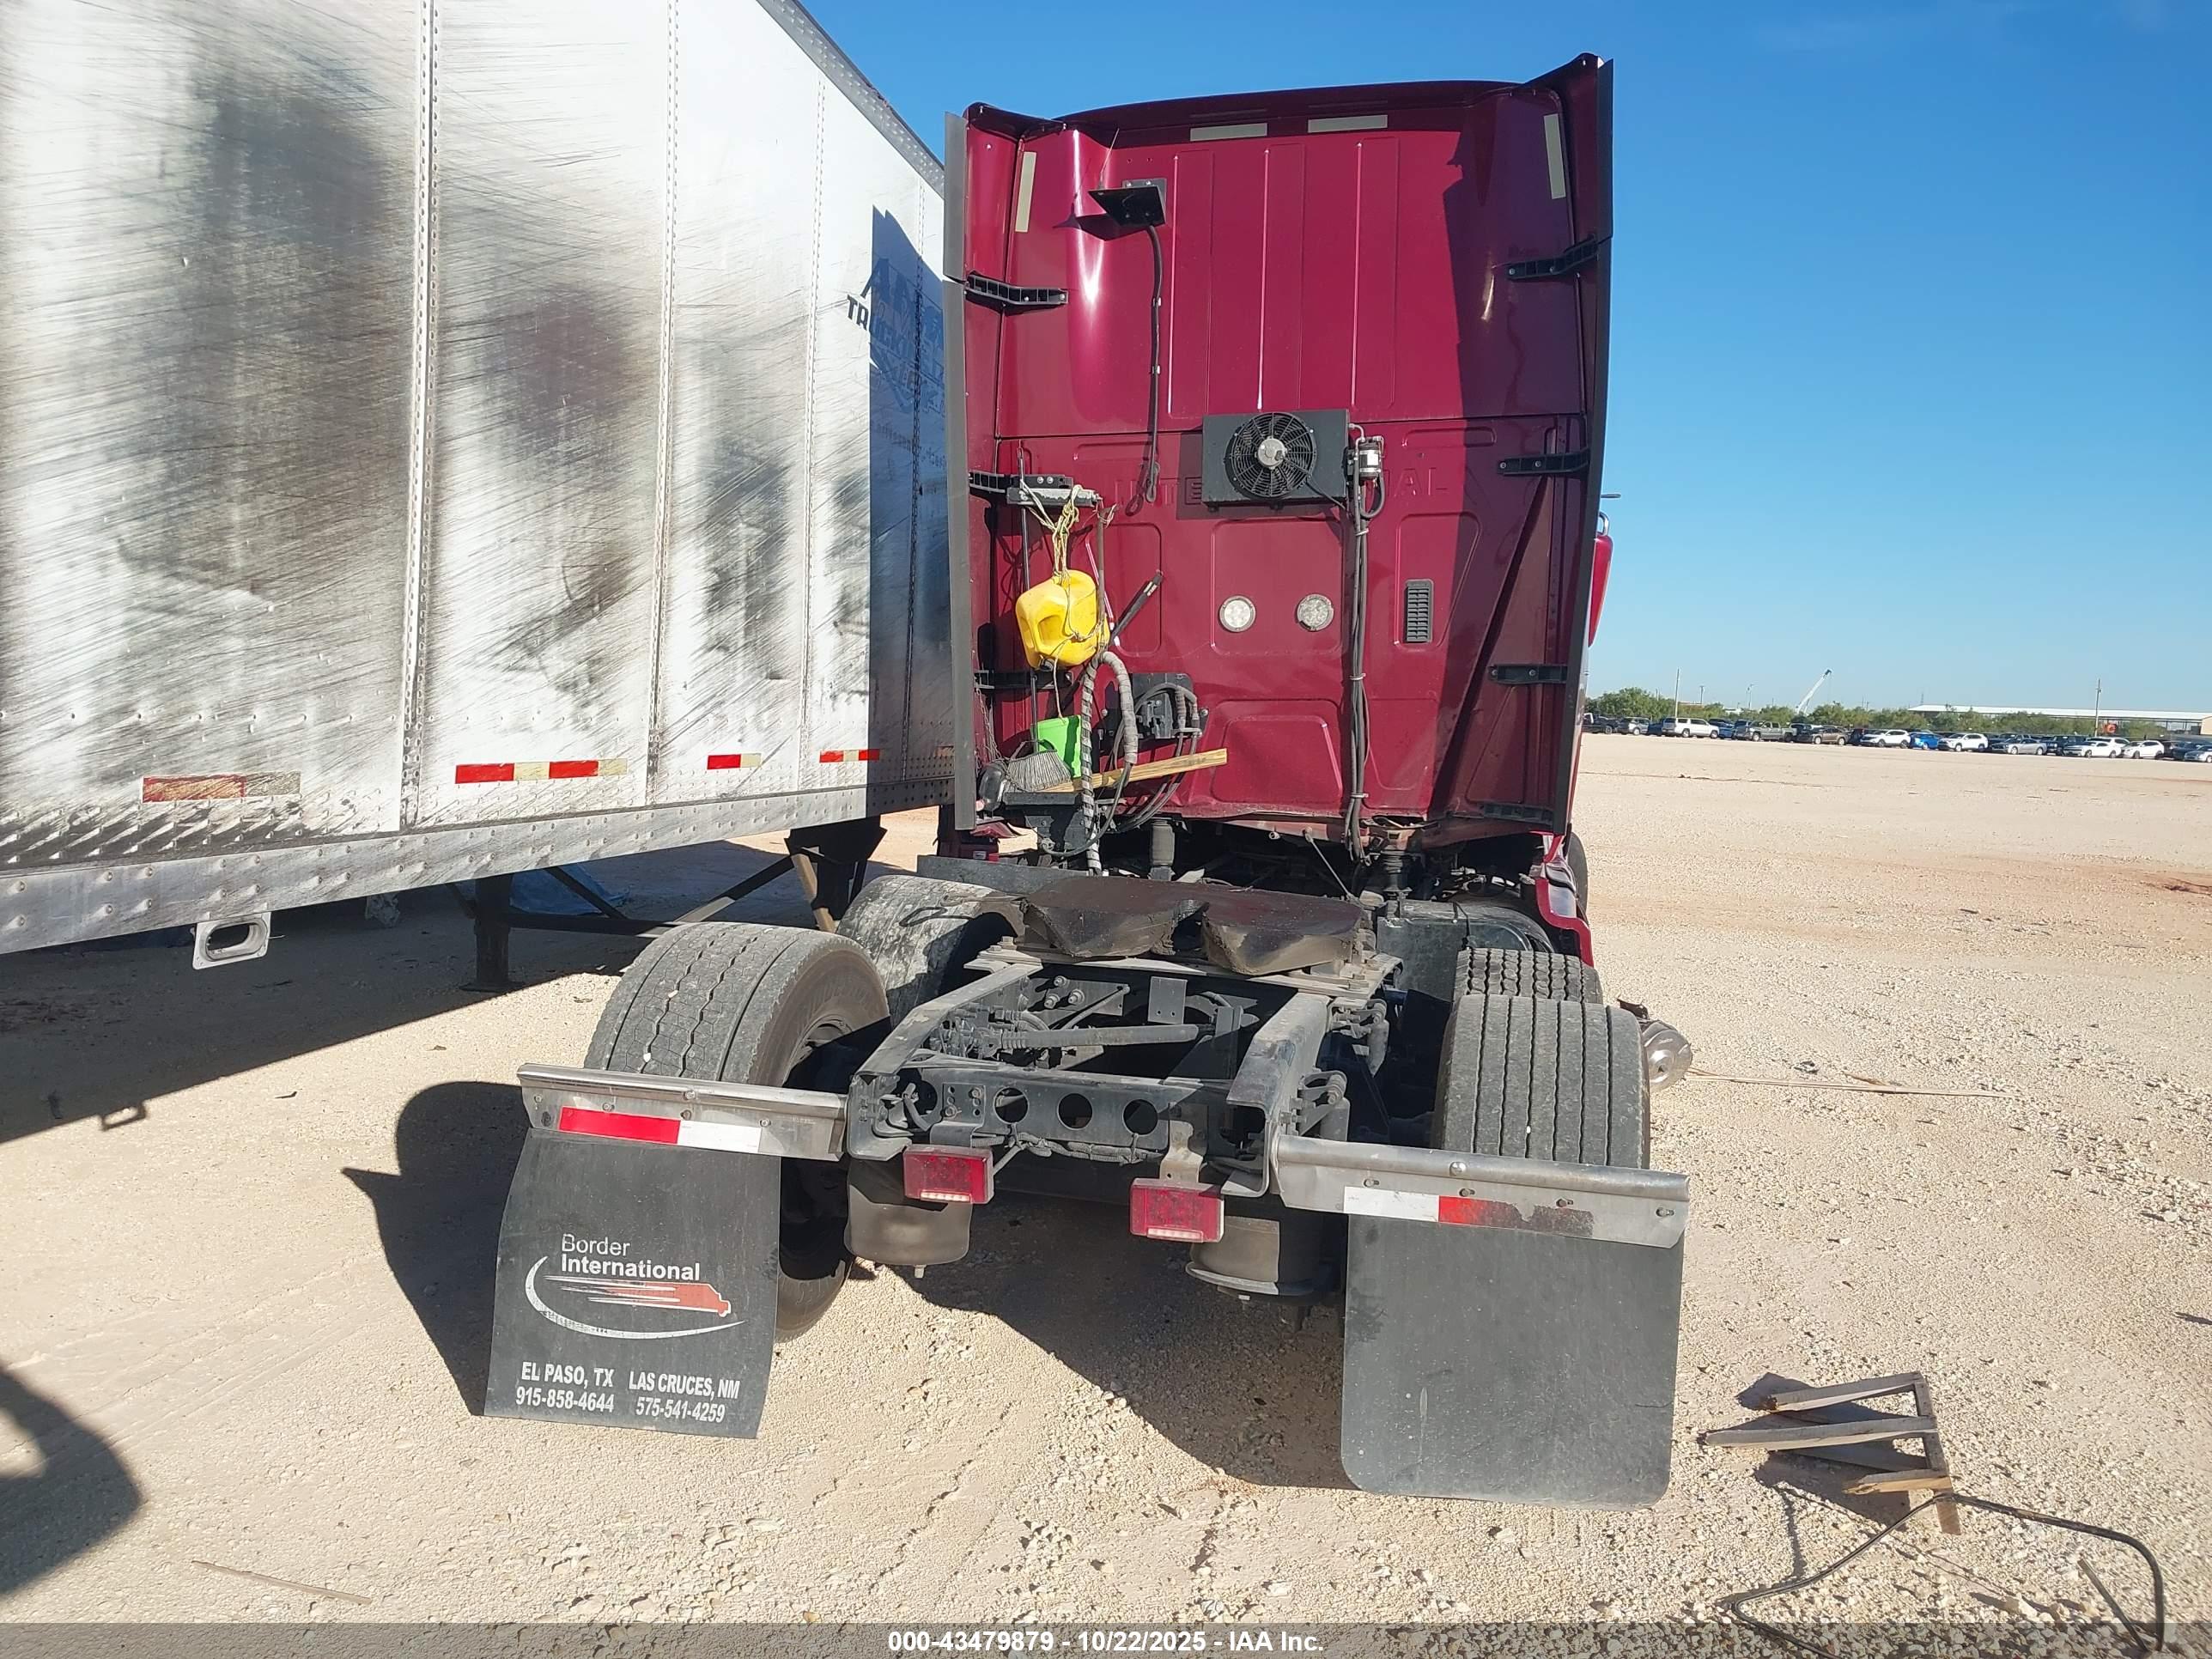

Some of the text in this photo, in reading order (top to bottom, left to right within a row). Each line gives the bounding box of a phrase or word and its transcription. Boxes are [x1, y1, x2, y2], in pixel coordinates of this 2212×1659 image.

[562, 1233, 630, 1256] Border
[562, 1253, 700, 1281] International
[521, 1361, 614, 1389] EL PASO, TX
[629, 1371, 740, 1401] LAS CRUCES, NM
[515, 1386, 615, 1413] 915-858-4644
[635, 1396, 726, 1424] 575-541-4259
